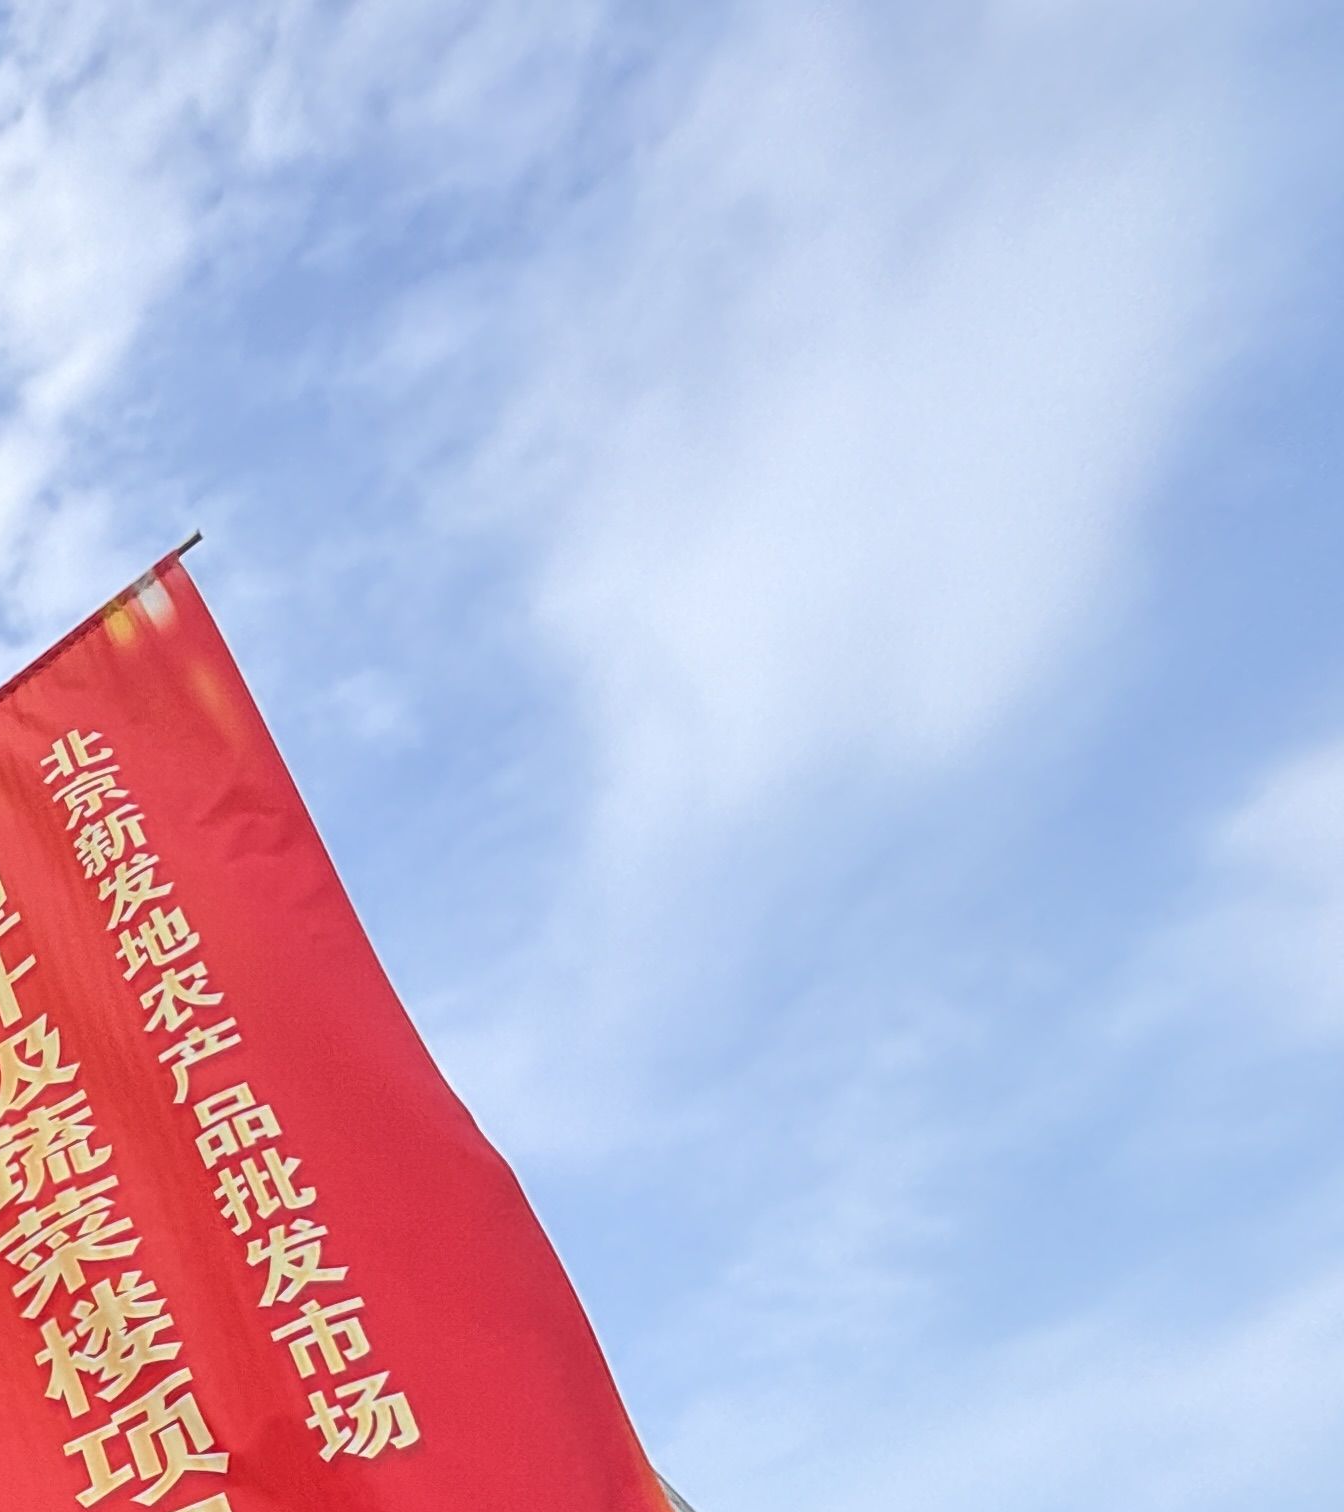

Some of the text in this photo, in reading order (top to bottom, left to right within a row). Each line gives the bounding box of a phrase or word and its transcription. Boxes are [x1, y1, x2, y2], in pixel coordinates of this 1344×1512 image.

[40, 728, 419, 1462] 北京新发地农产品批发市场
